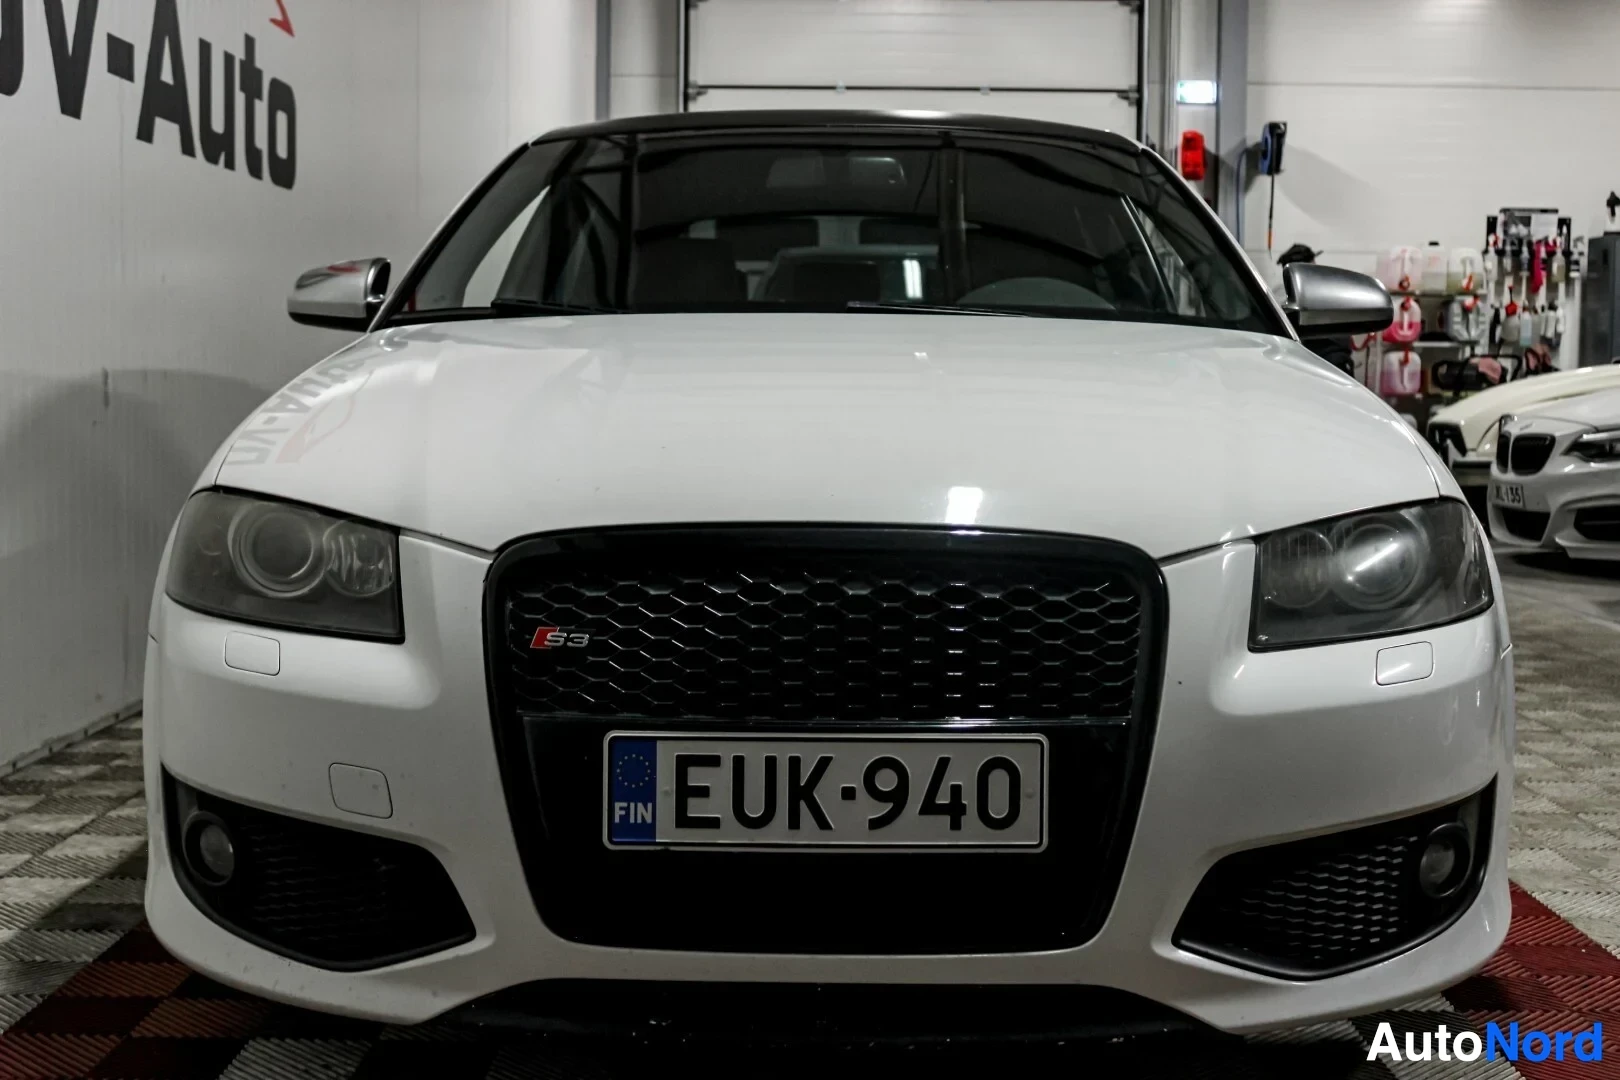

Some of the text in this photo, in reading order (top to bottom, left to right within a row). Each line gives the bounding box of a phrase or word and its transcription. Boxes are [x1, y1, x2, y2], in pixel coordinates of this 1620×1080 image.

[543, 632, 590, 648] S3
[674, 752, 1023, 831] EUK-940
[614, 801, 653, 824] FIN
